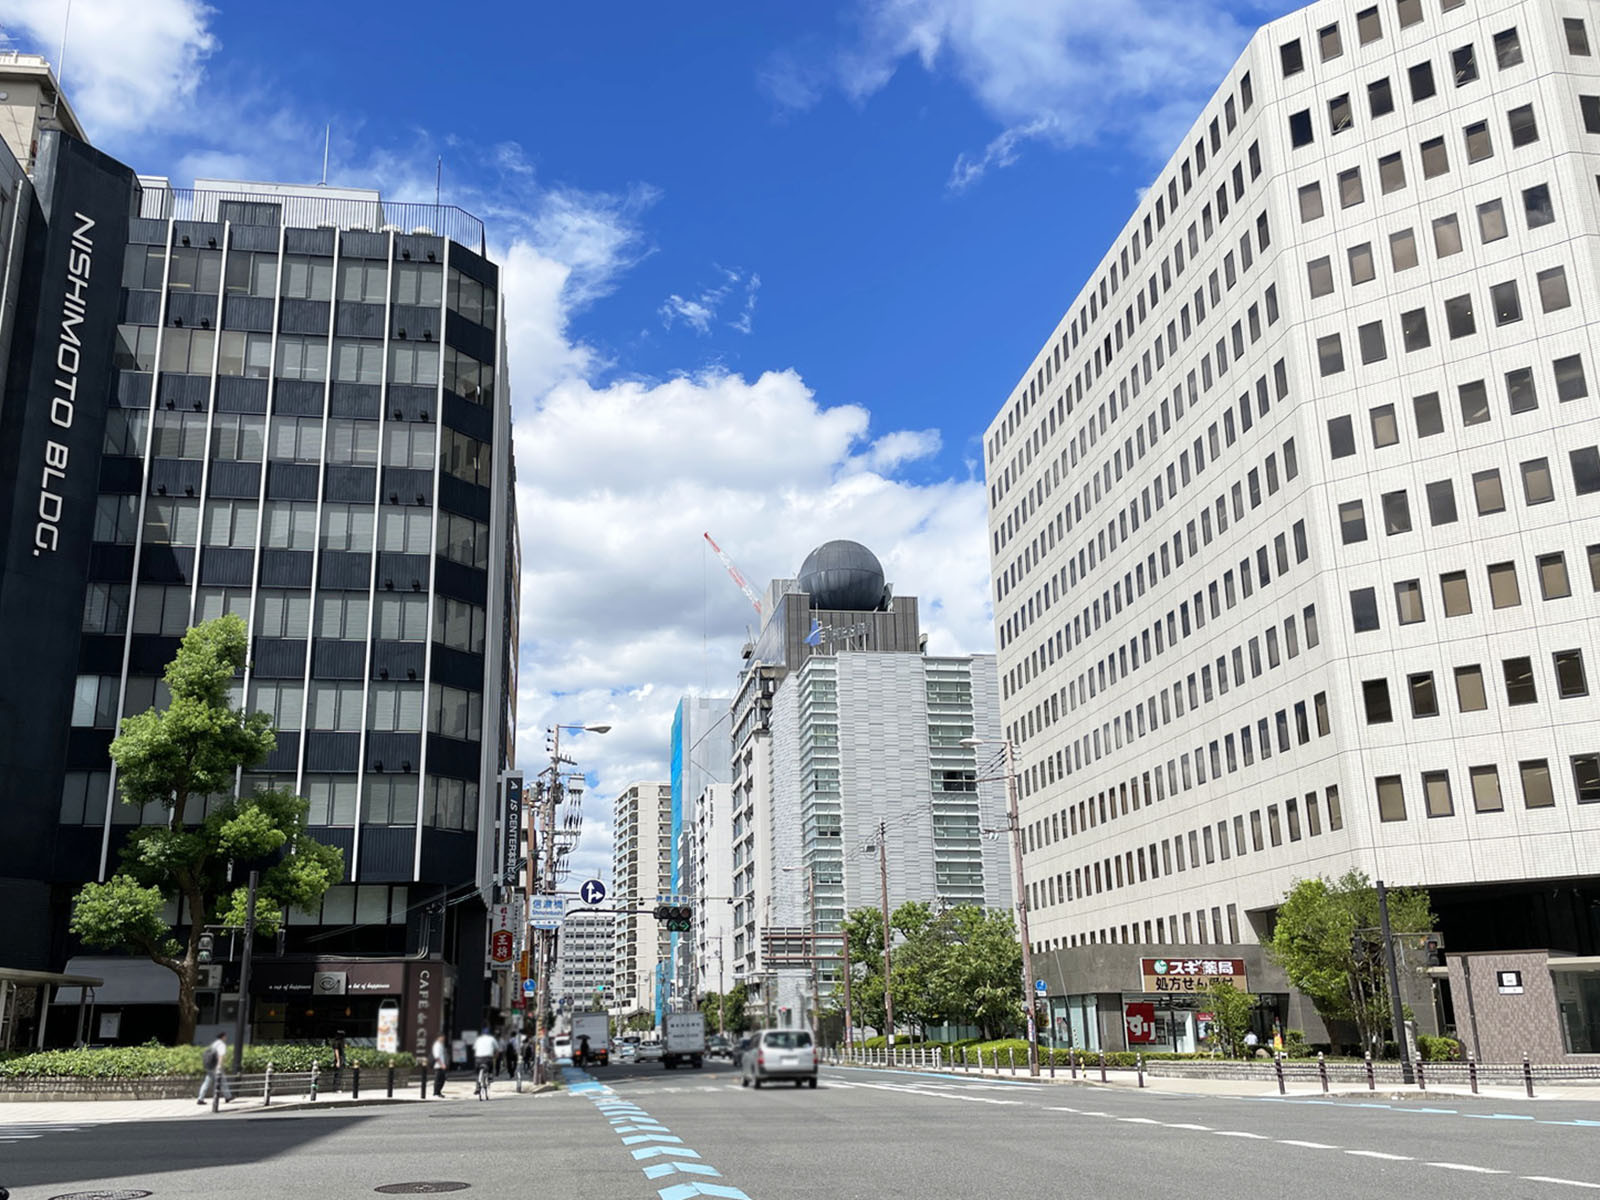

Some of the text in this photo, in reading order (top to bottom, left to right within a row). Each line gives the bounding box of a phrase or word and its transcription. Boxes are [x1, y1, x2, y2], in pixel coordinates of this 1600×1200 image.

[33, 211, 96, 557] NISHIMOTO BLDG.
[1169, 960, 1234, 975] スギ薬局
